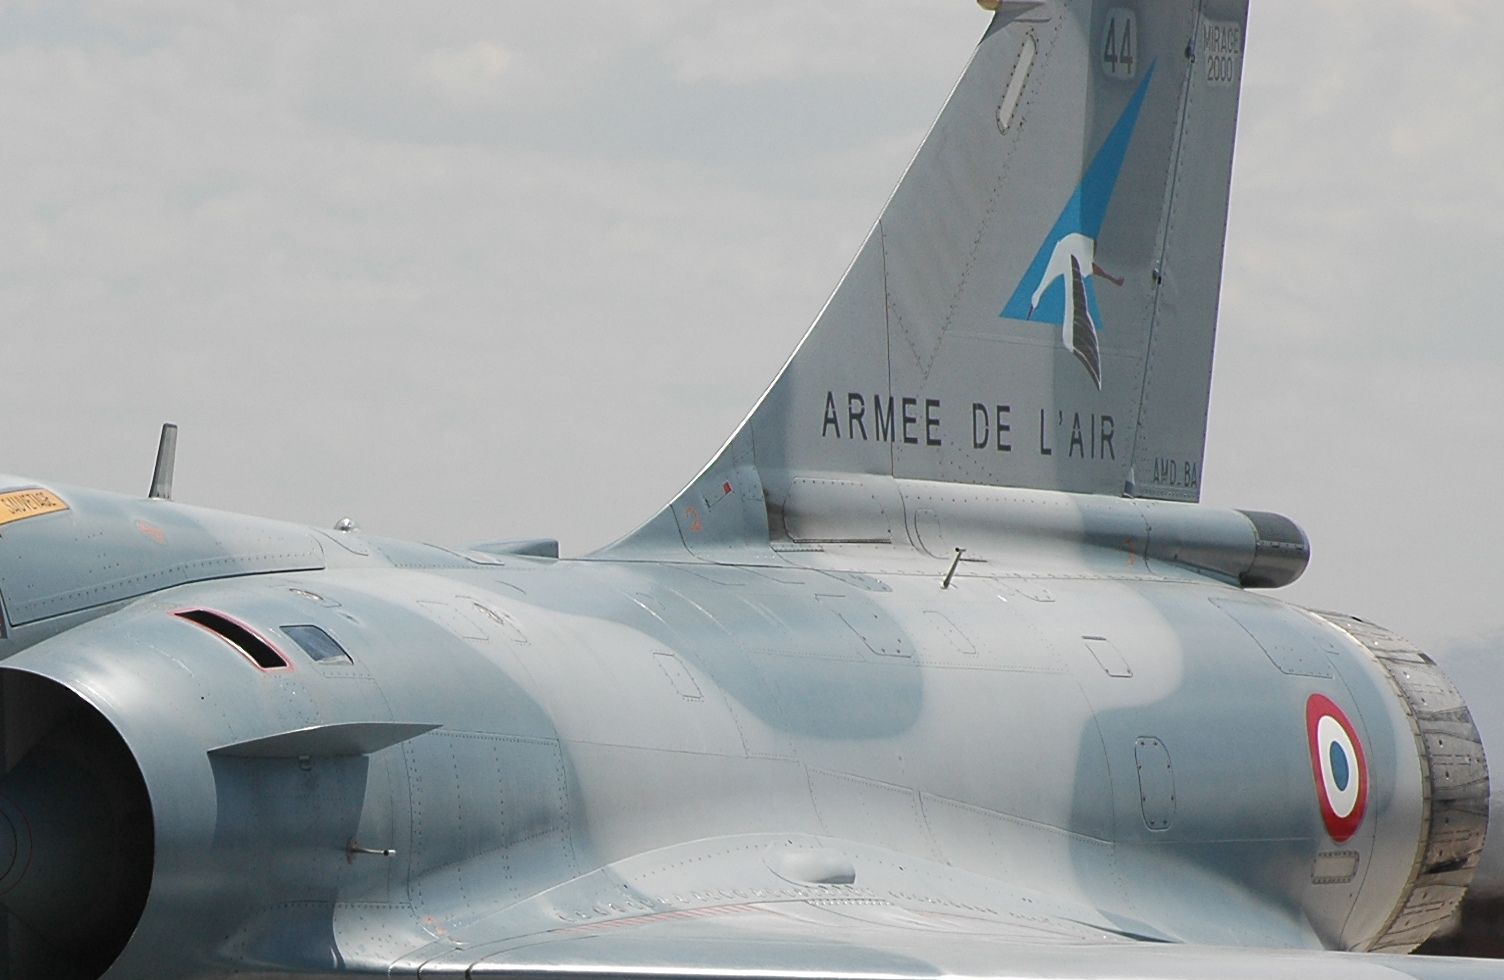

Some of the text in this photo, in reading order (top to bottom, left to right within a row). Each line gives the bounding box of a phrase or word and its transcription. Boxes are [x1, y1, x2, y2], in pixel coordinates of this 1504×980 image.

[1104, 17, 1134, 75] 44
[1203, 26, 1240, 54] MIRAGE
[1207, 55, 1234, 82] 2000
[822, 391, 1115, 460] ARMEE DE L'AIR
